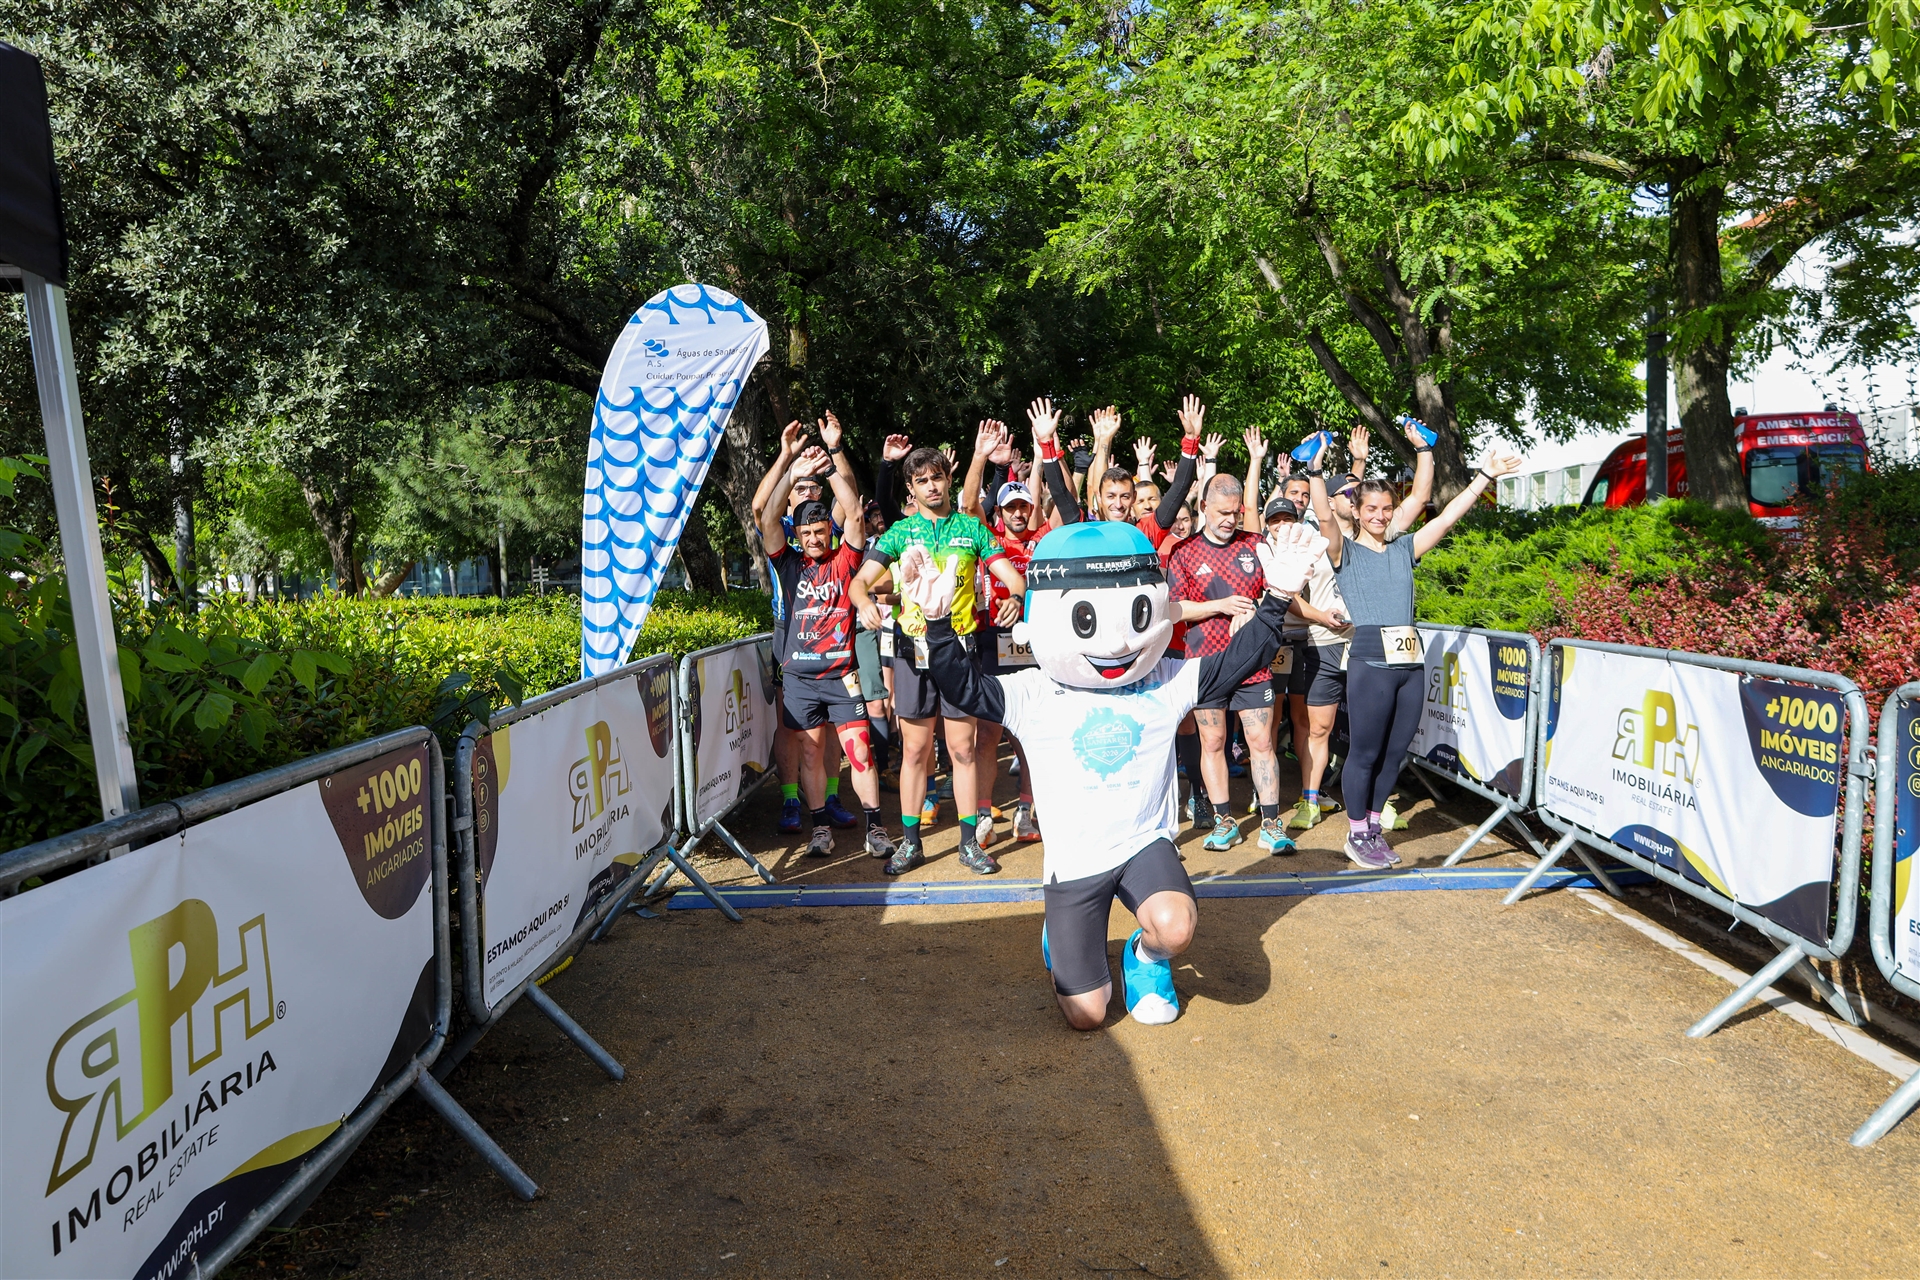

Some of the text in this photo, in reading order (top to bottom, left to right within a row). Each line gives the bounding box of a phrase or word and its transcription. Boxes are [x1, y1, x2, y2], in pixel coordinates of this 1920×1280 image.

[647, 360, 665, 368] A.S.
[676, 348, 701, 359] Águas
[703, 348, 713, 357] de
[646, 372, 674, 380] Cuidar.
[676, 372, 705, 381] Poupar.
[1756, 416, 1850, 431] AMBULÂNCIA
[1757, 432, 1850, 446] EMERGÊNCIA
[1086, 562, 1100, 570] PACE
[1395, 637, 1417, 652] 207
[1498, 646, 1527, 667] +1000
[1497, 667, 1526, 686] IMÓVEIS
[1495, 685, 1525, 699] ANGARIADOS
[1765, 695, 1838, 734] +1000
[1761, 729, 1837, 764] IMÓVEIS
[1761, 755, 1836, 785] ANGARIADOS
[356, 758, 422, 815] +1000
[1586, 789, 1598, 802] POR
[1612, 768, 1697, 811] IMOBILIÁRIA
[1631, 794, 1673, 816] REAL ESTATE
[363, 804, 423, 861] IMÓVEIS
[366, 837, 424, 890] ANGARIADOS
[487, 893, 570, 965] ESTAMOS AQUI POR SI
[53, 1049, 278, 1257] IMOBILIÁRIA
[123, 1124, 221, 1233] REAL ESTATE
